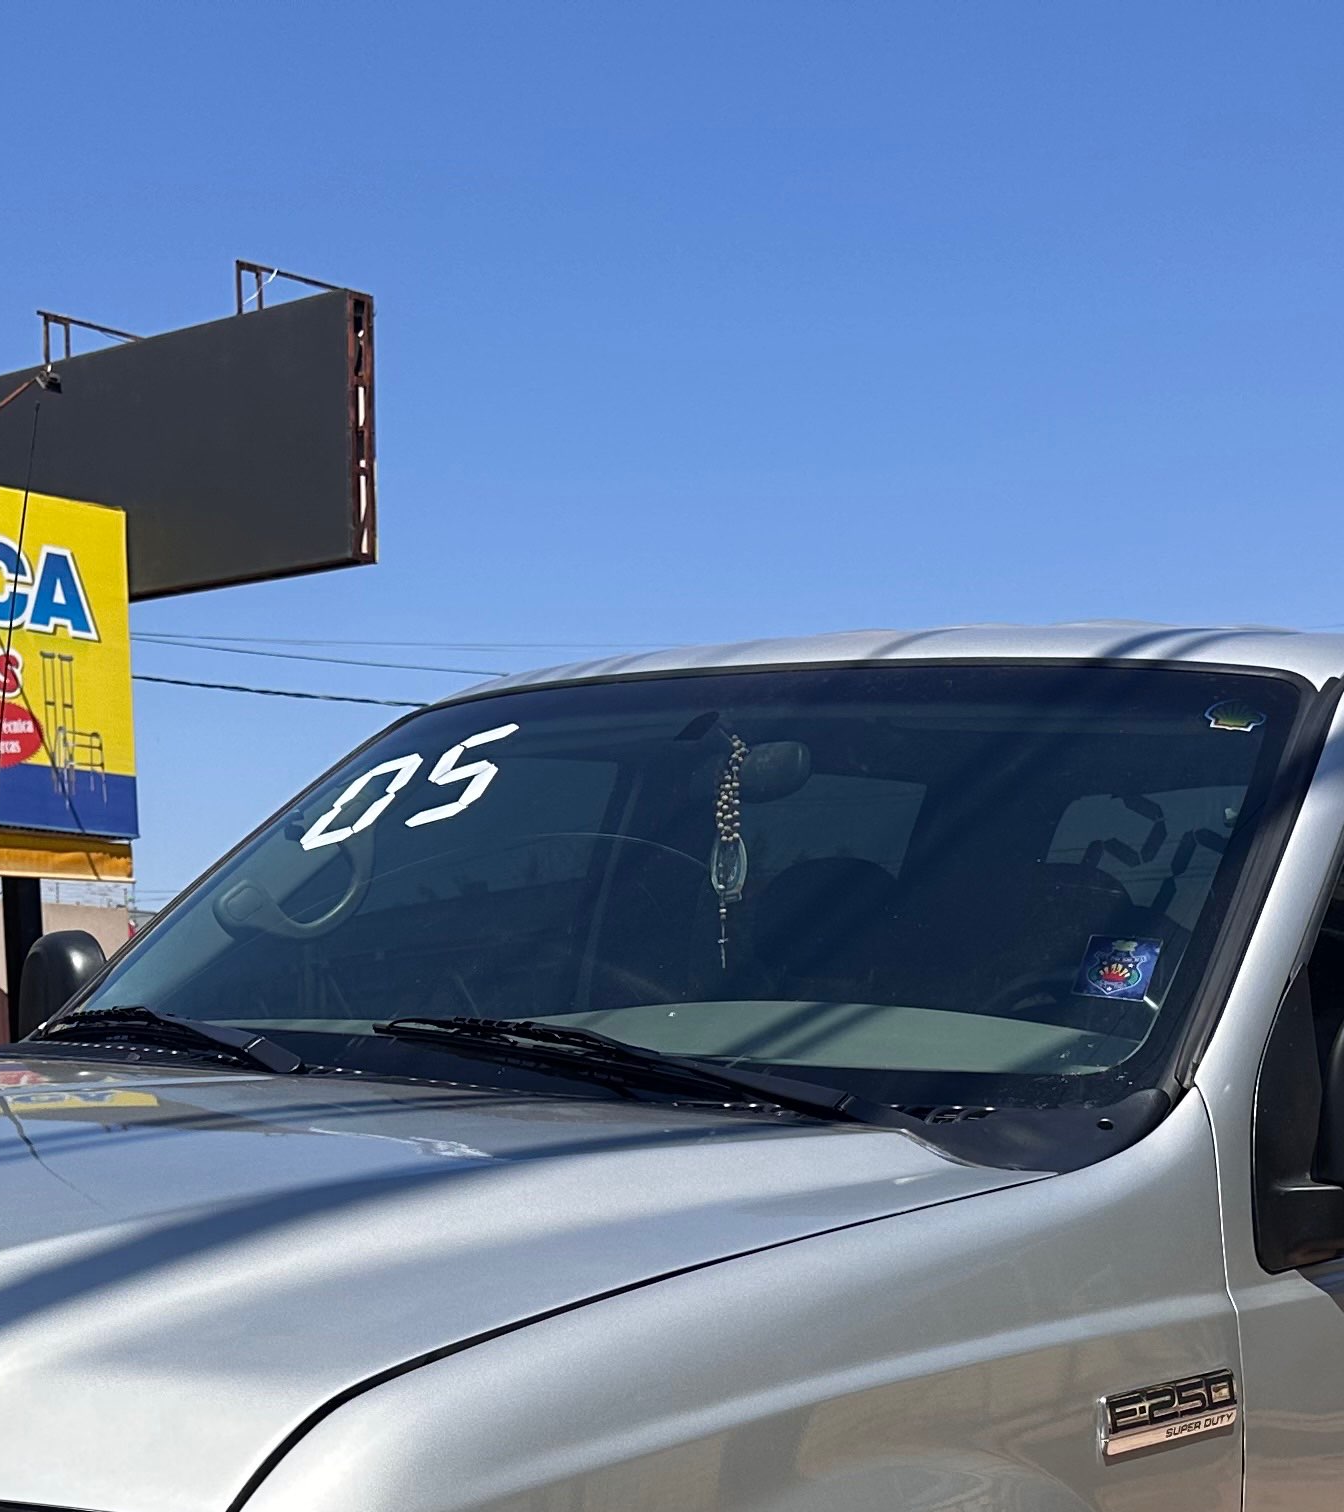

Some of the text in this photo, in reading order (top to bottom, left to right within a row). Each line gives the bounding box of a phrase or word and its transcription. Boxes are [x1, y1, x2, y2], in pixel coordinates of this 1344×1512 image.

[299, 722, 520, 851] 05
[1165, 1412, 1234, 1438] SUPER DUTY
